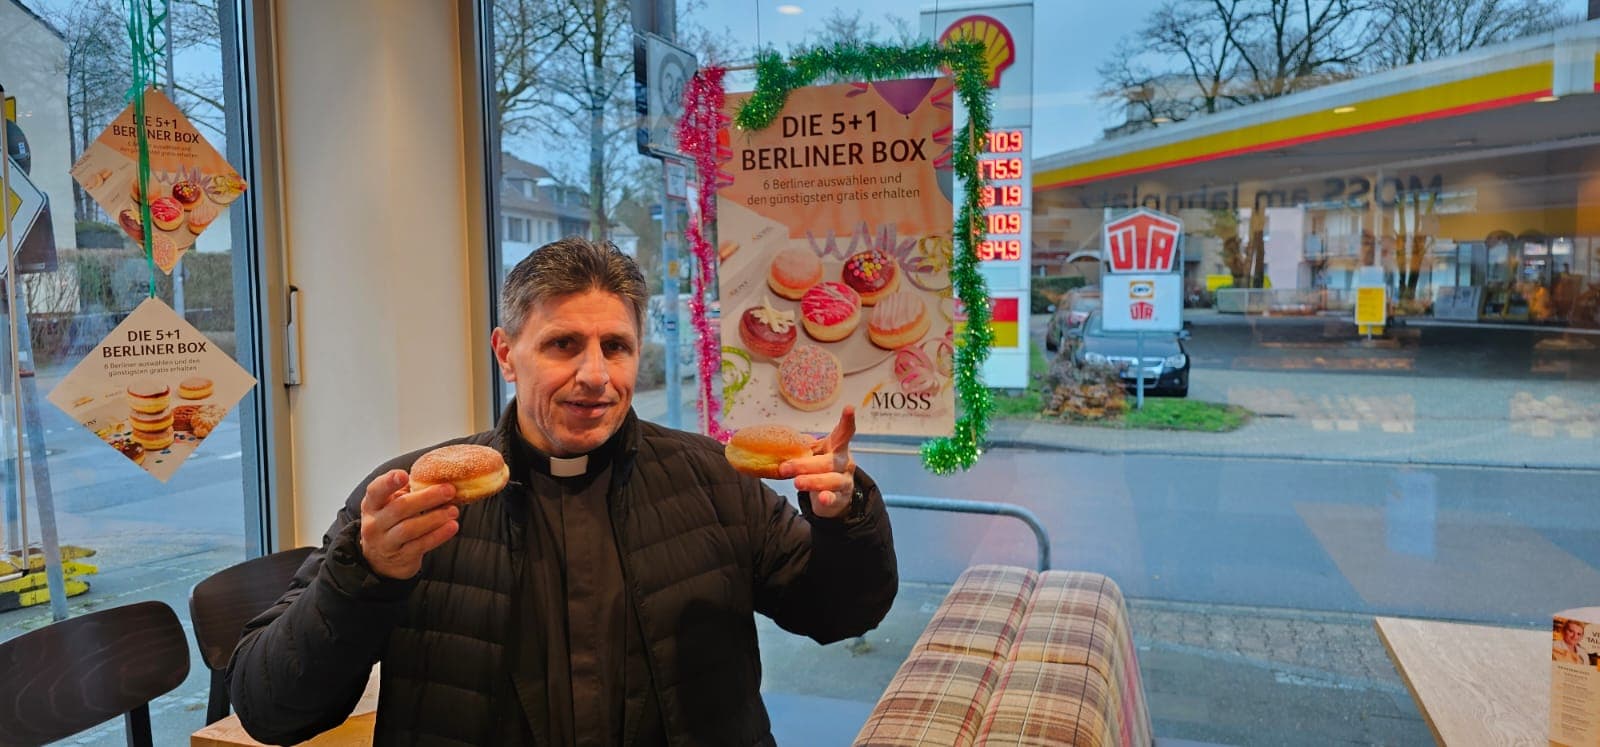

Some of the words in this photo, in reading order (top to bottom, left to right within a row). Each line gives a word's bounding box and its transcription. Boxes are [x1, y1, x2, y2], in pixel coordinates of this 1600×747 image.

[155, 117, 178, 129] 5+1
[782, 114, 823, 138] DIE
[831, 110, 877, 135] 5+1
[174, 132, 200, 144] BOX
[742, 142, 864, 171] BERLINER
[872, 137, 927, 164] BOX
[763, 180, 770, 190] 6
[773, 177, 815, 190] Berliner
[817, 173, 877, 189] auswählen
[880, 172, 902, 184] und
[747, 194, 767, 206] den
[769, 191, 834, 207] günstigsten
[837, 189, 869, 205] gratis
[871, 187, 921, 200] erhalten
[1107, 213, 1178, 270] UTA
[1129, 302, 1154, 321] UTA
[127, 330, 152, 342] DIE
[156, 329, 180, 341] 5+1
[103, 343, 174, 358] BERLINER
[178, 342, 207, 354] BOX
[110, 361, 137, 369] Berliner
[138, 359, 174, 367] auswählen
[872, 391, 931, 410] MOSS
